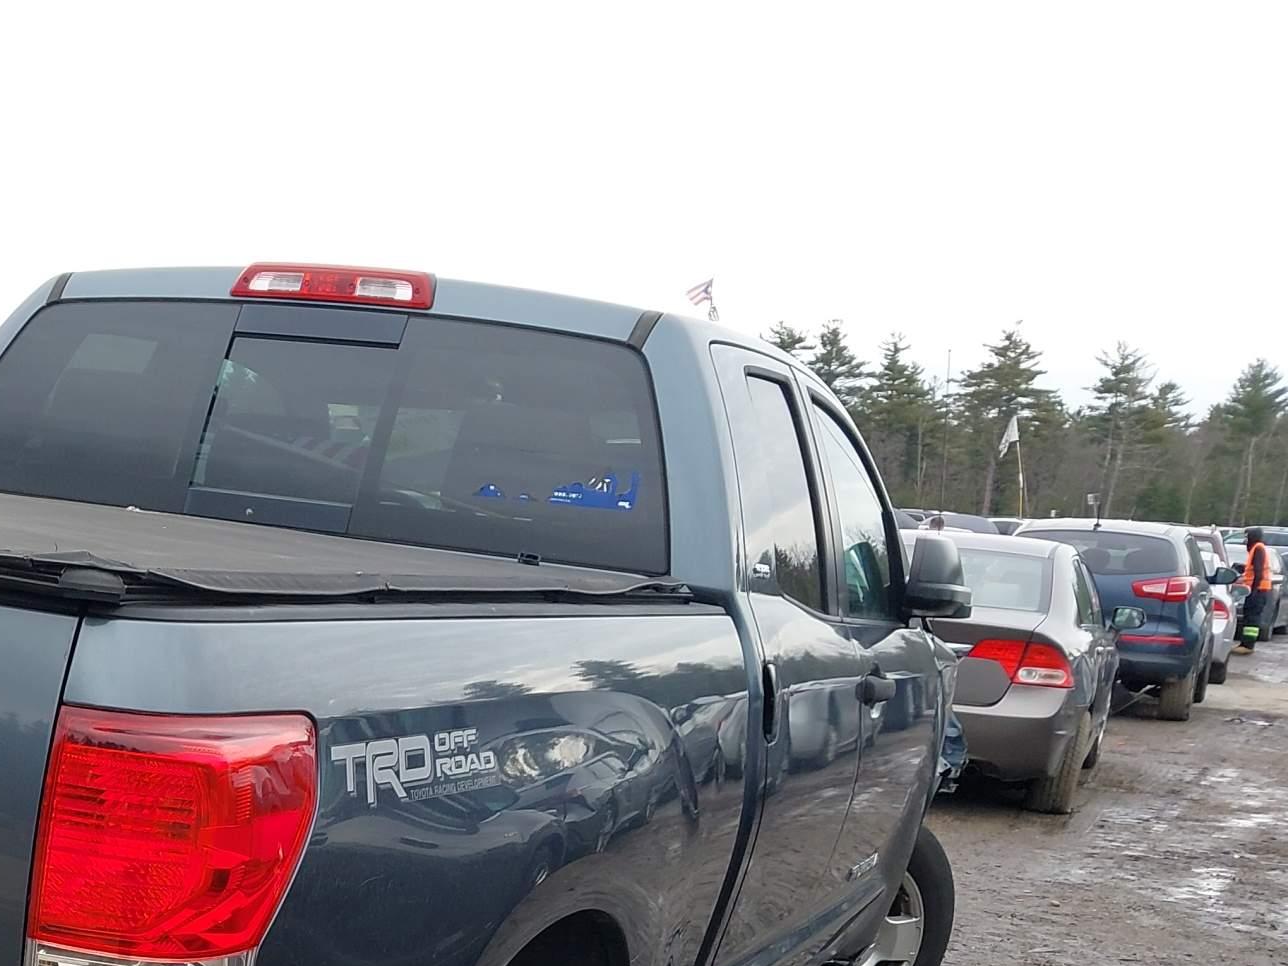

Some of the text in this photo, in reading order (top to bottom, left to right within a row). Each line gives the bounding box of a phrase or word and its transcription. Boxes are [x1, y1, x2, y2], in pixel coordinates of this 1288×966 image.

[434, 728, 478, 753] OFF
[330, 735, 432, 804] TRD
[435, 751, 497, 779] ROAD
[410, 786, 434, 800] TOYOTA
